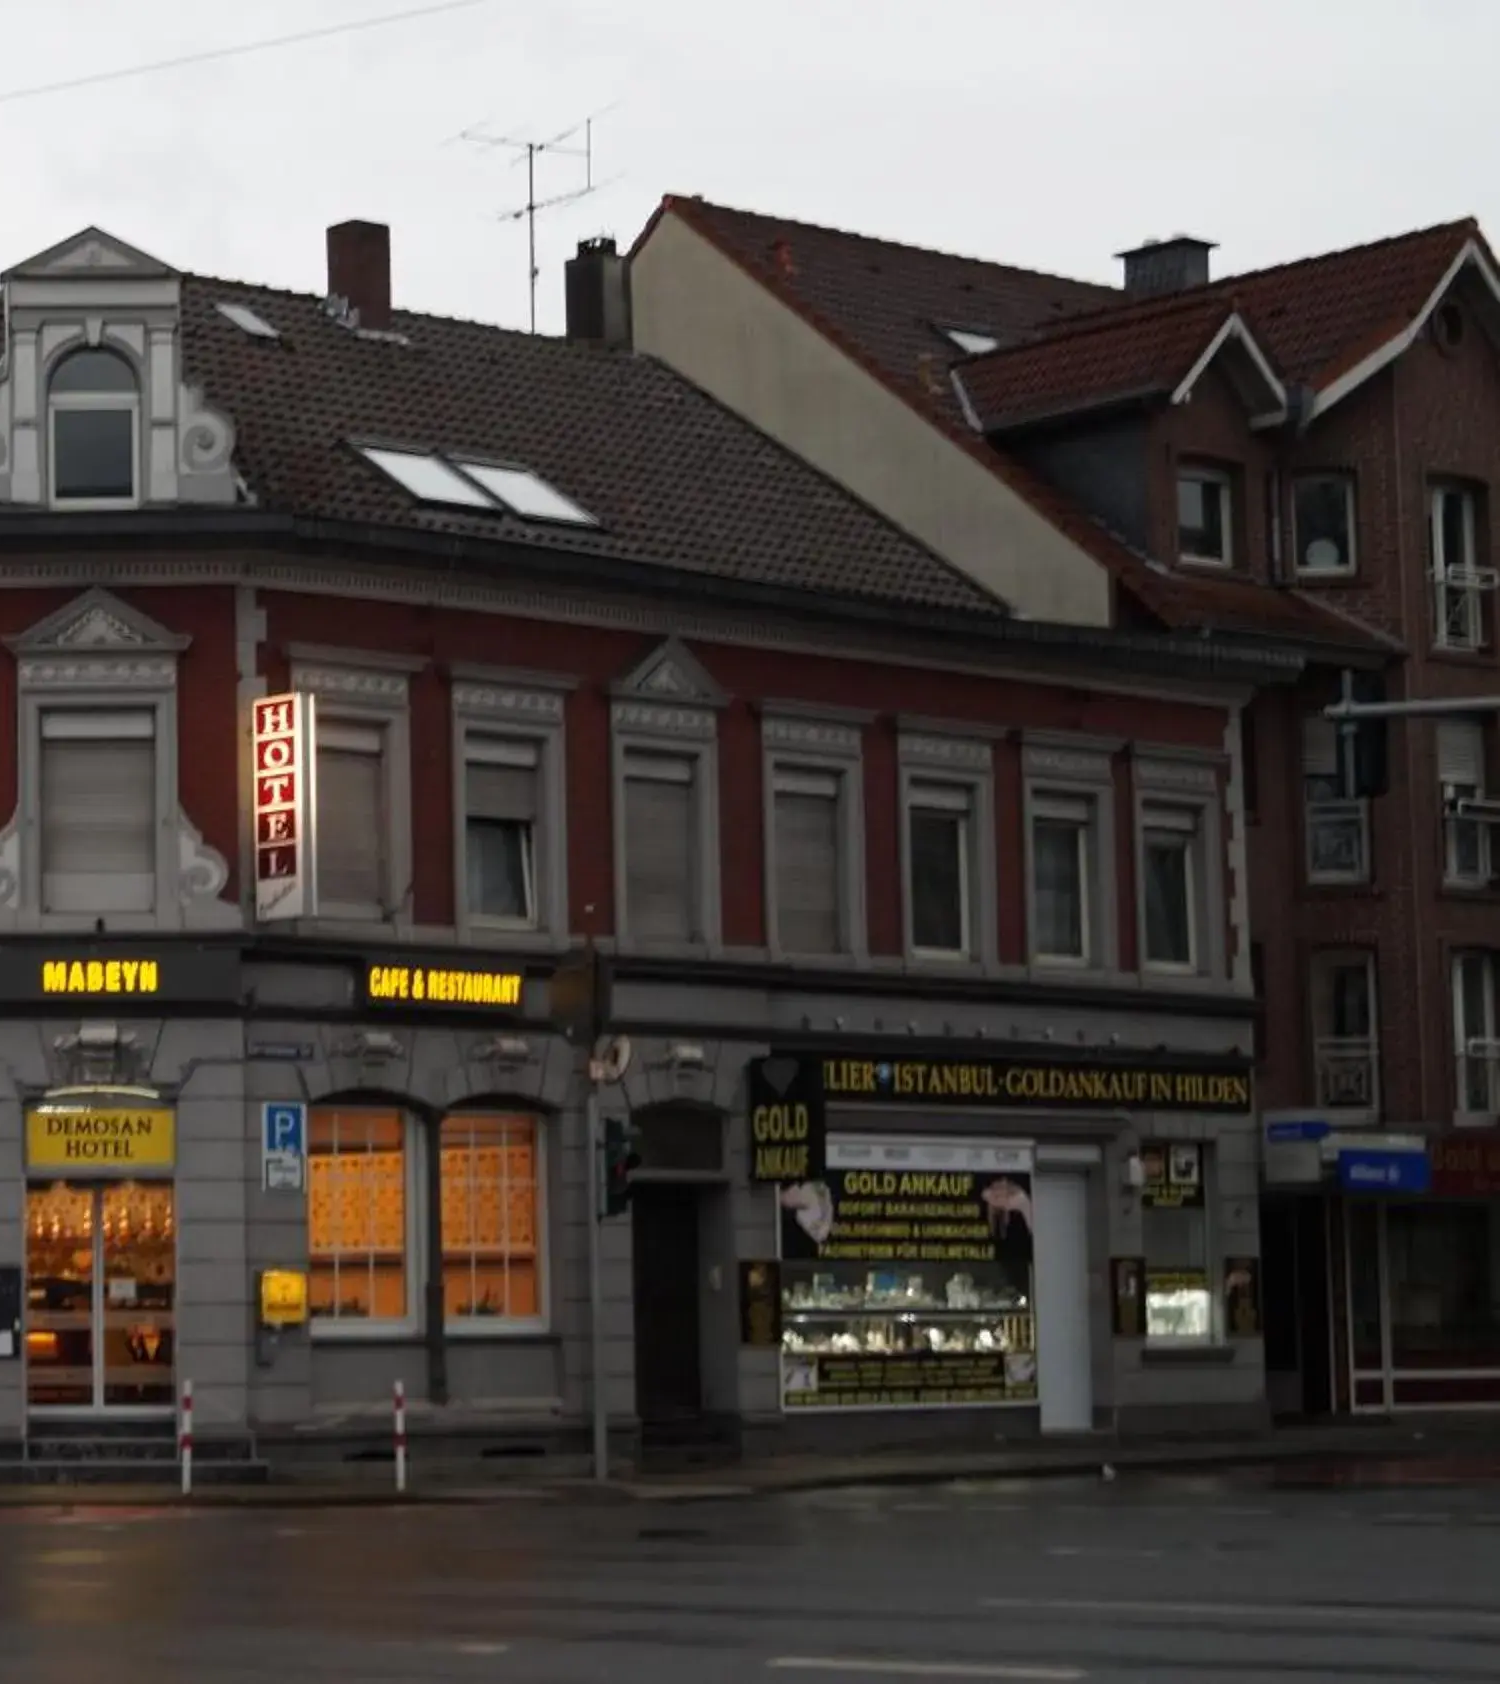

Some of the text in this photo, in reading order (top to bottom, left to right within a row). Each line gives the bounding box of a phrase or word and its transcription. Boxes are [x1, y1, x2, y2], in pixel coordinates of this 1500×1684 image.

[262, 703, 290, 877] HOTEL
[43, 961, 158, 992] MABEYN
[369, 966, 522, 1004] CAFE & RESTAURANT
[1176, 1075, 1247, 1104] HILDEN
[47, 1117, 152, 1136] DEMOSAN
[274, 1110, 294, 1148] P
[753, 1102, 809, 1142] GOLD
[66, 1139, 134, 1158] HOTEL
[755, 1145, 810, 1181] ANKAUF
[844, 1171, 975, 1197] GOLD ANKAUF
